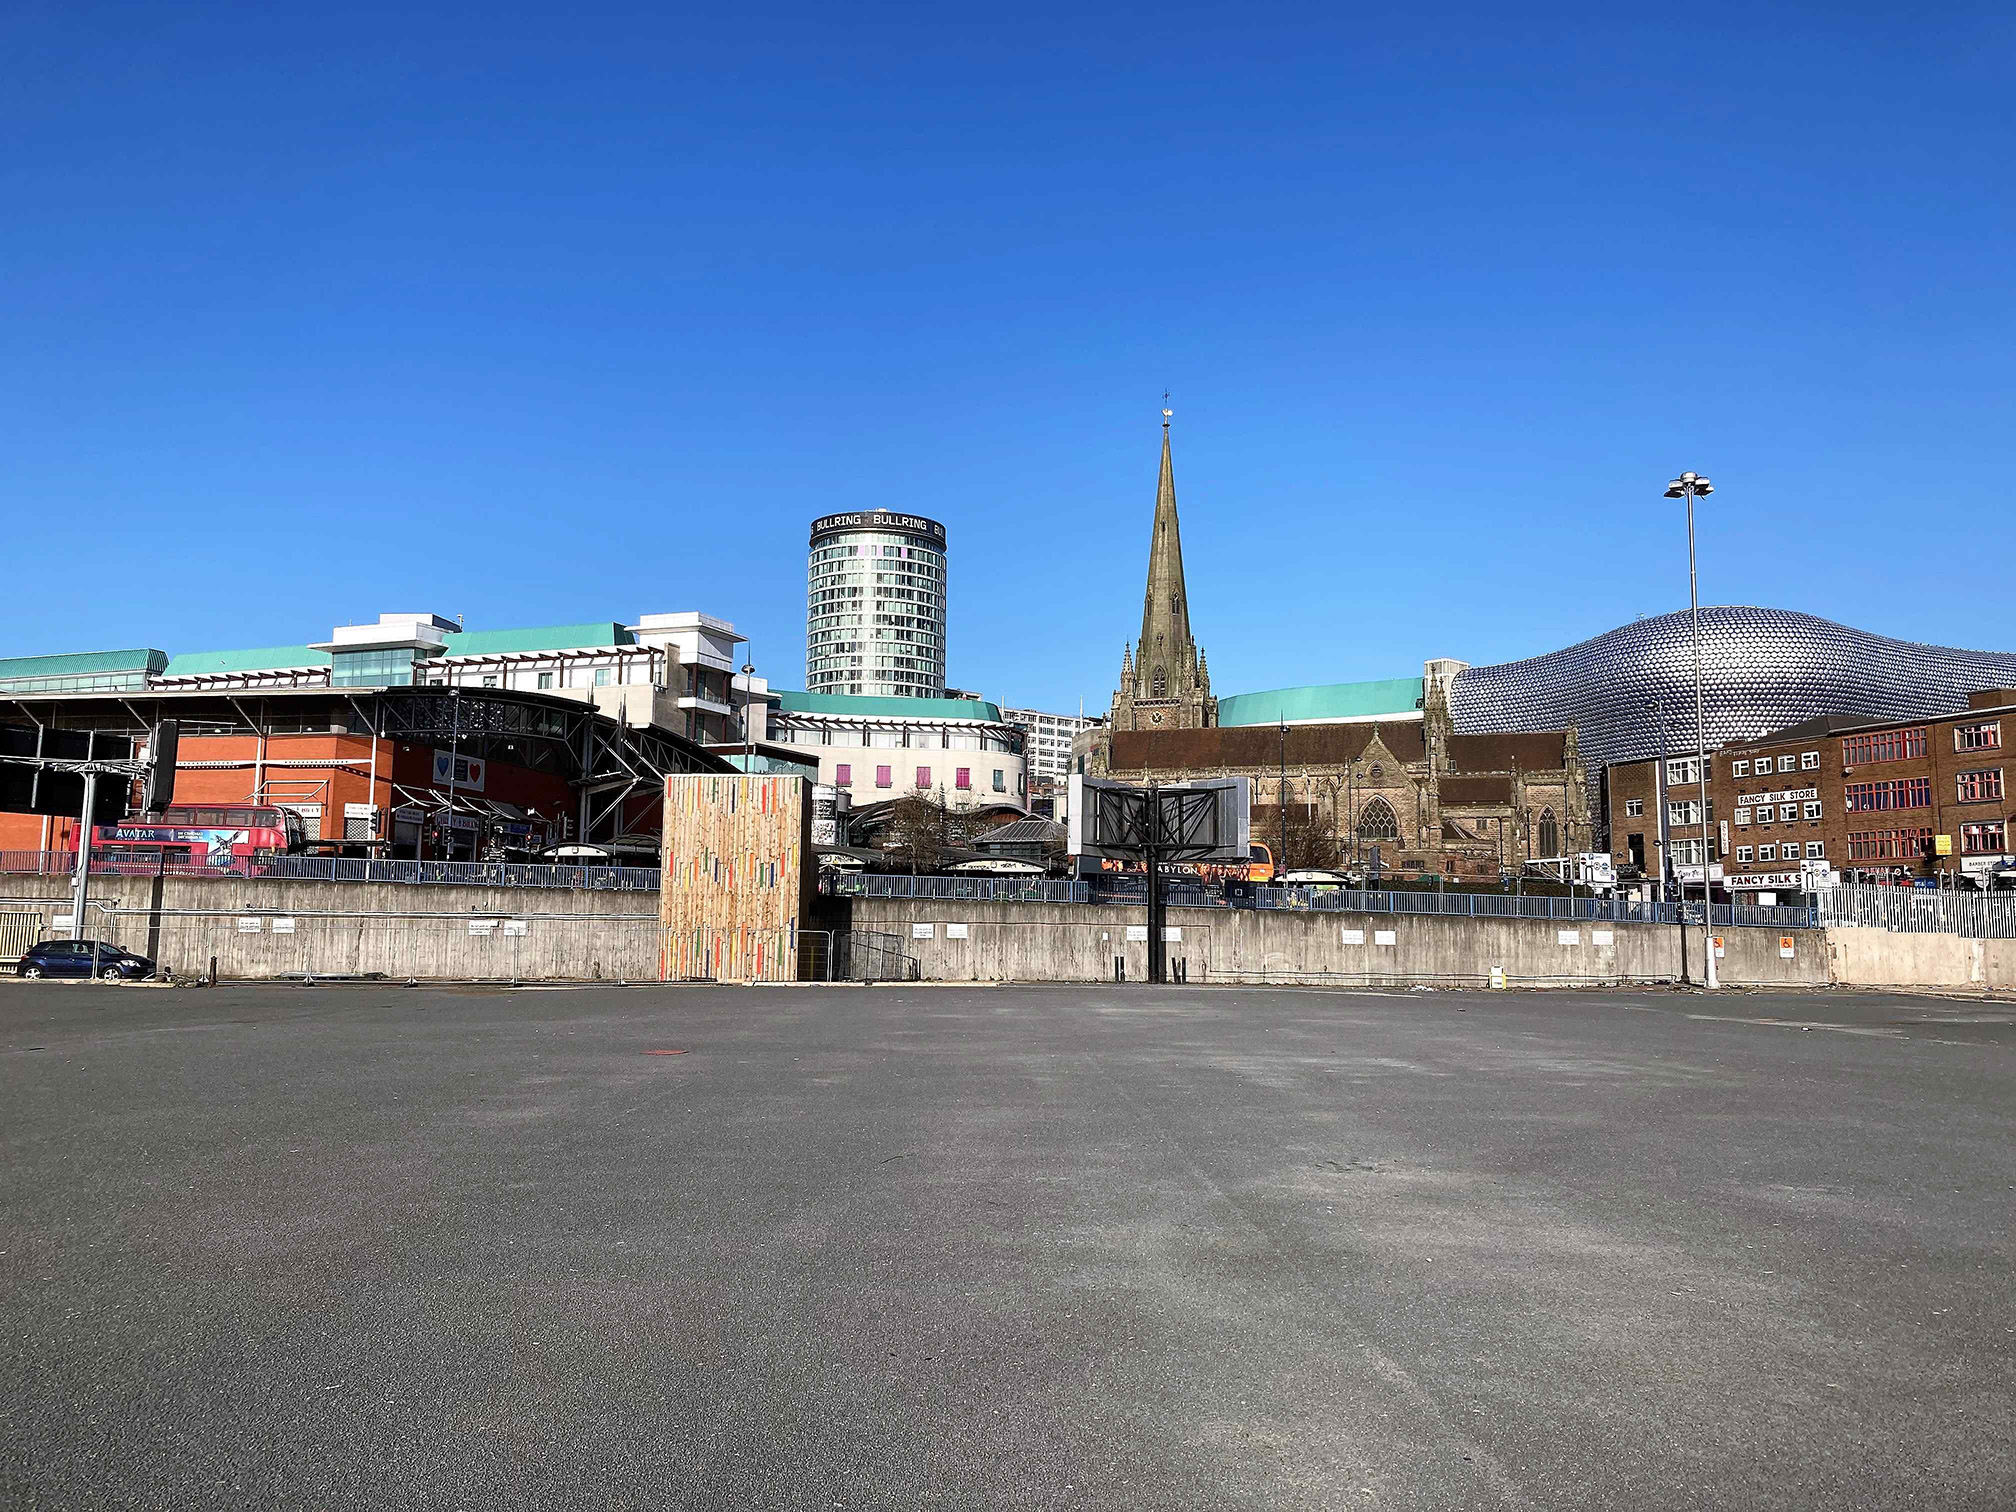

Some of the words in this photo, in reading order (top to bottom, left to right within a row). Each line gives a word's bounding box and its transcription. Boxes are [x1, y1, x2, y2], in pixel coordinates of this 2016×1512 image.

[816, 515, 862, 531] BULLRING
[873, 514, 927, 530] BULLRING
[1740, 794, 1765, 804] FANCY
[1769, 792, 1786, 802] SILK
[1790, 789, 1815, 800] STORE
[115, 828, 155, 838] AVATAR
[1156, 865, 1198, 875] ABYLON
[1731, 875, 1764, 886] FANCY
[1768, 874, 1791, 884] SILK
